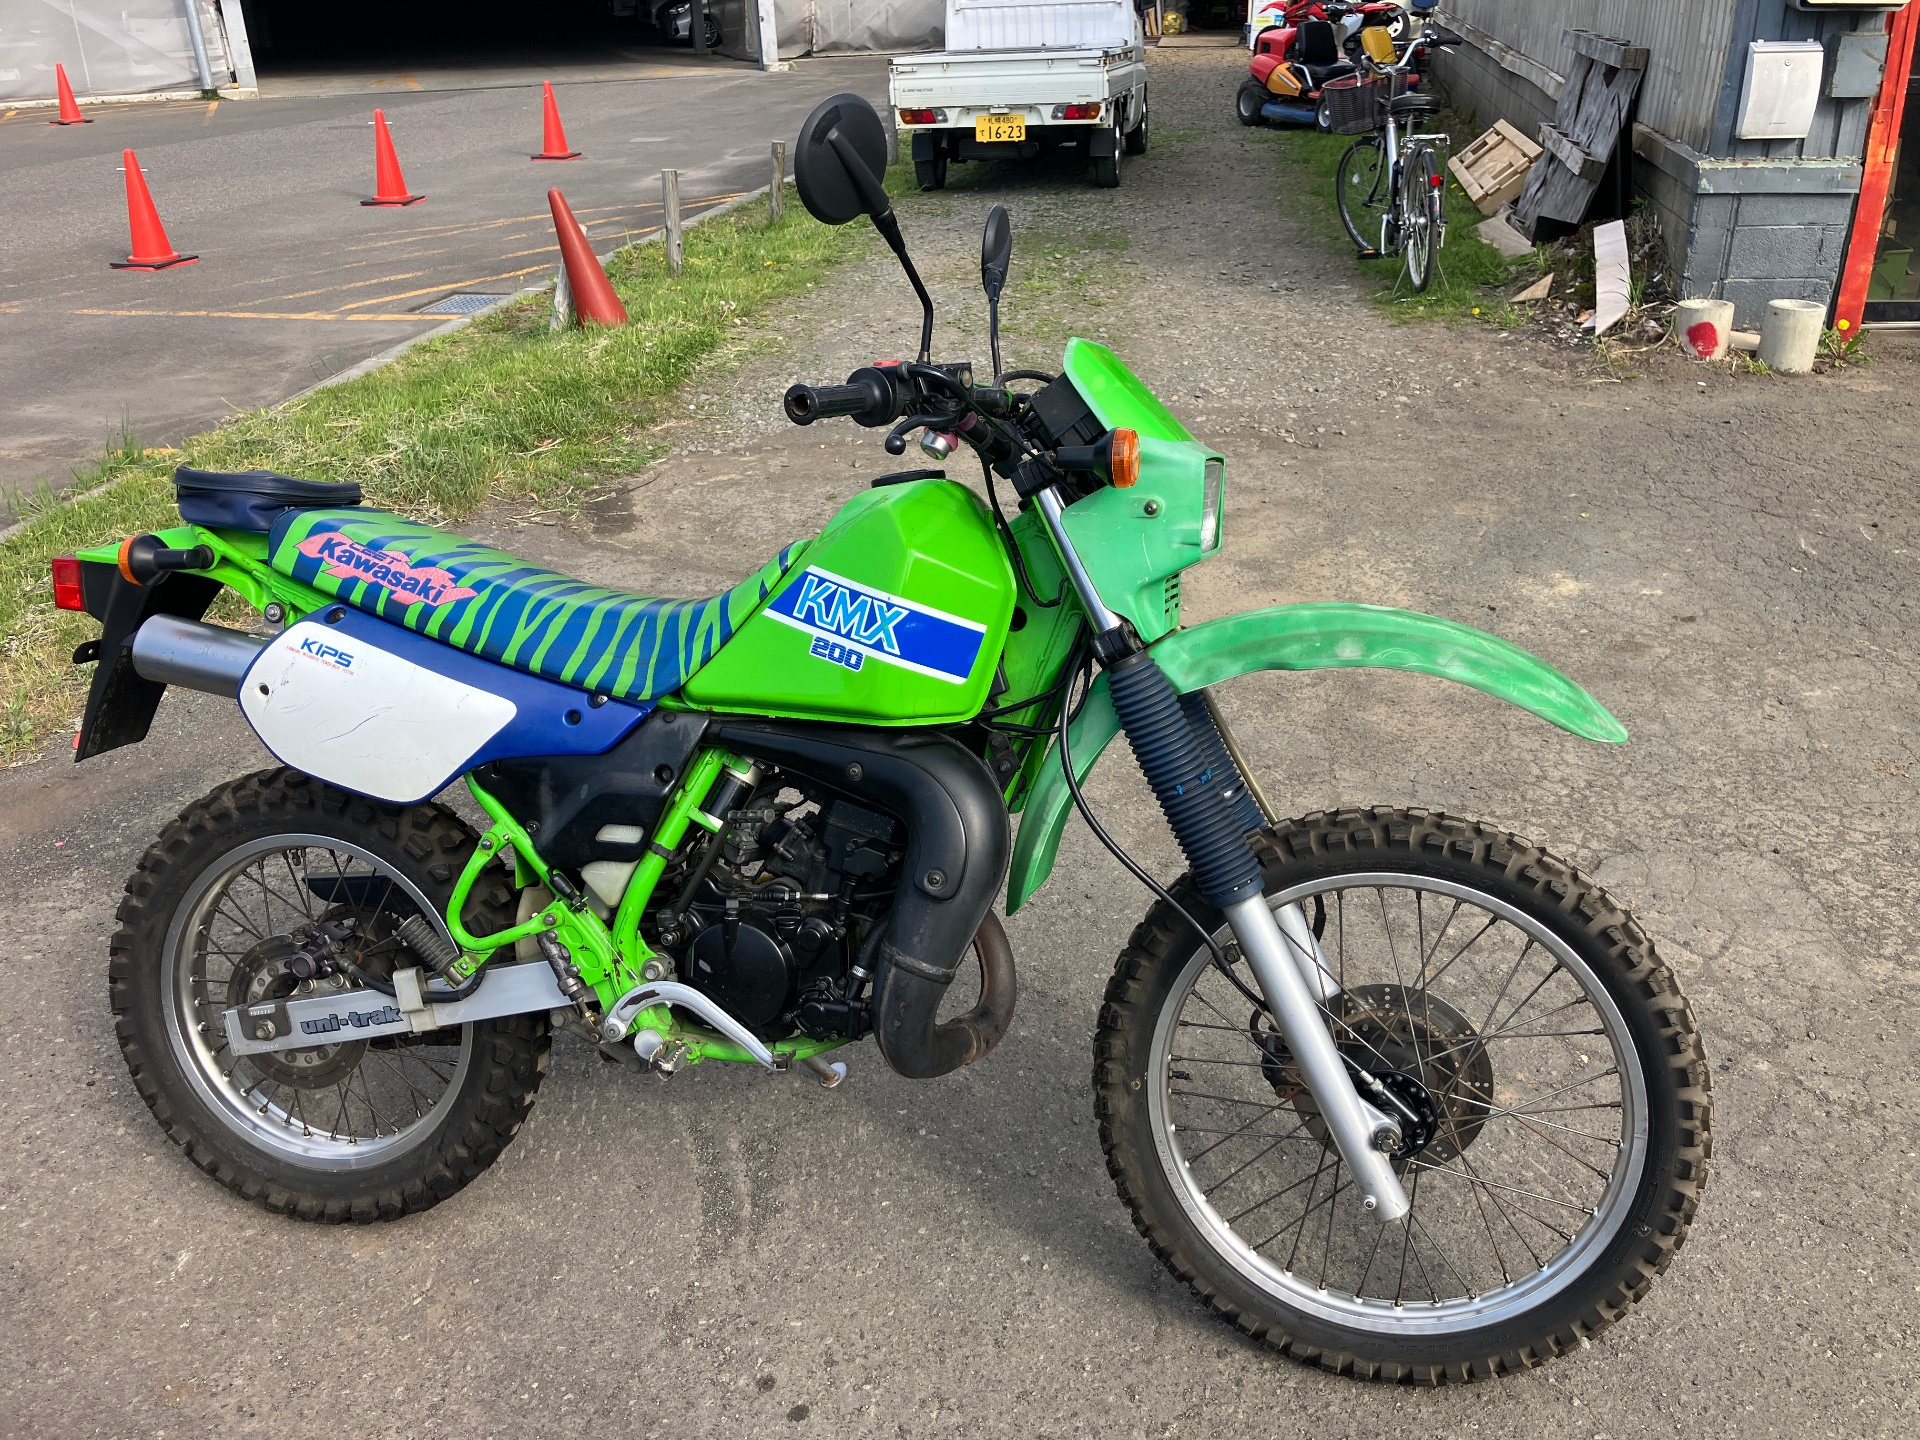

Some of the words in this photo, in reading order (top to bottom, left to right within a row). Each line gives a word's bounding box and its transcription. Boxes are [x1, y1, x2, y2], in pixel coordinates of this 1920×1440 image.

[988, 125, 1023, 140] 16-23
[317, 536, 447, 603] Kawasaki
[793, 575, 910, 655] KMX
[300, 637, 355, 668] KIPS
[809, 635, 865, 672] 200
[300, 1005, 404, 1035] uni-trak
